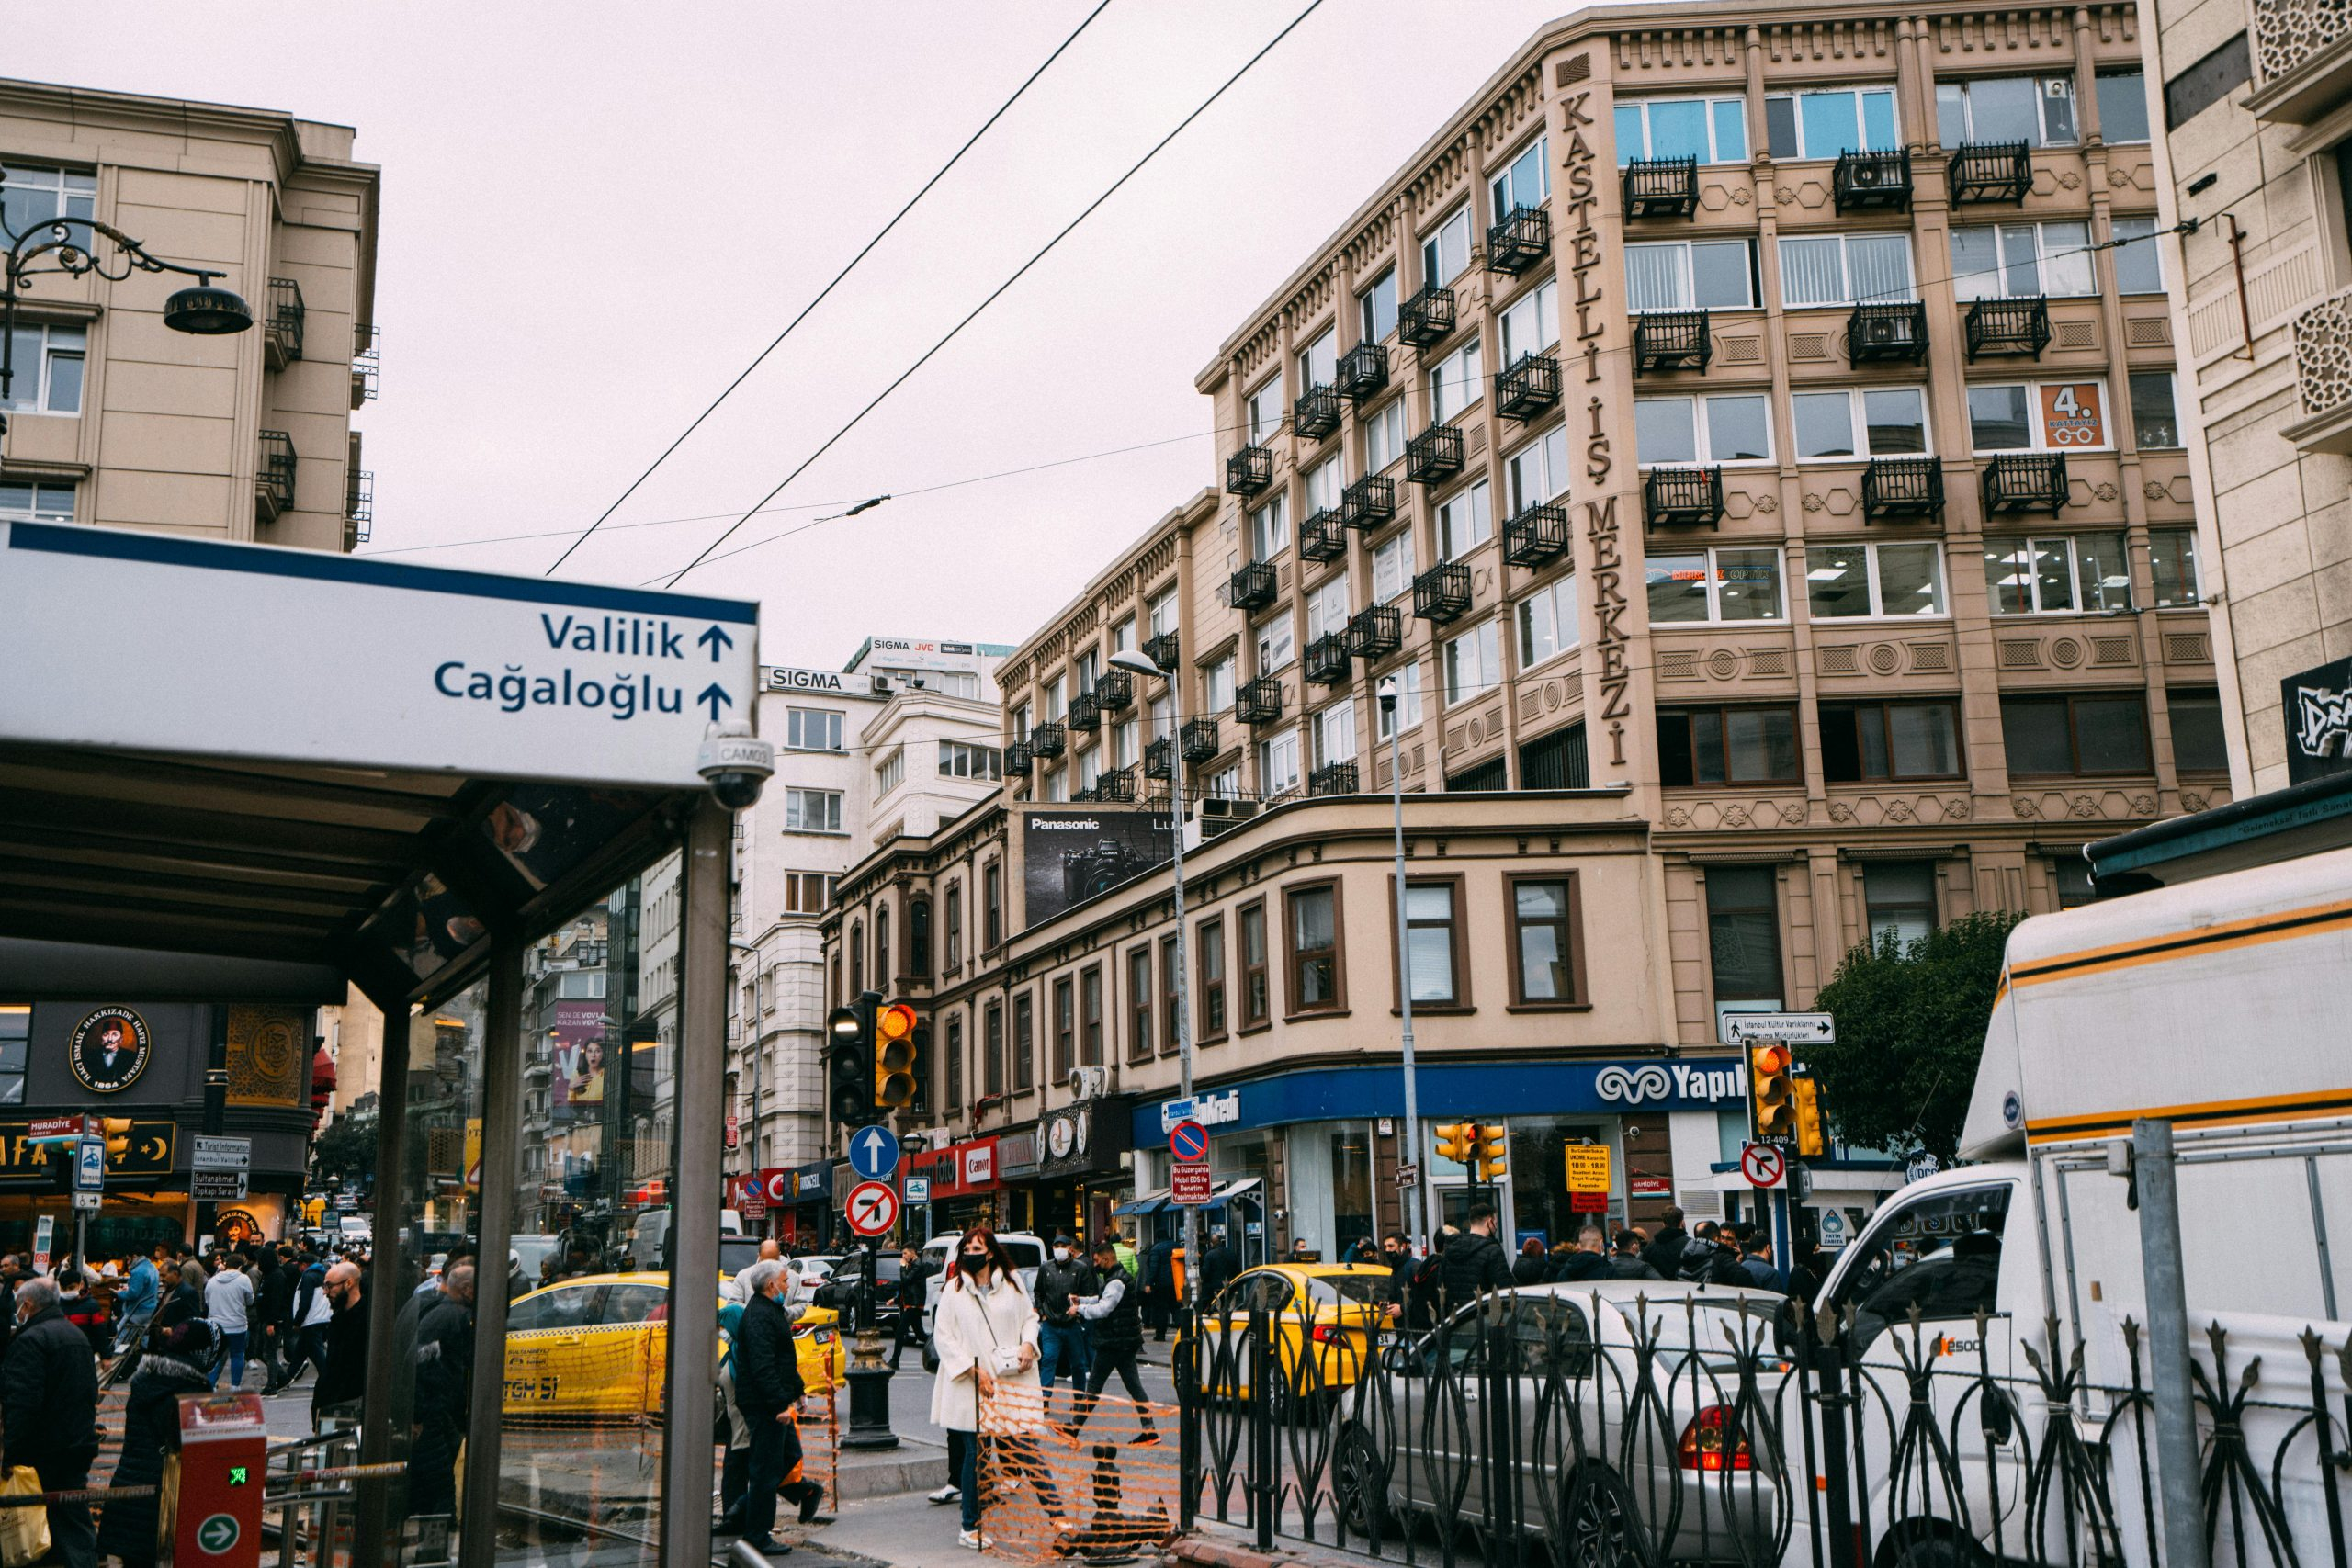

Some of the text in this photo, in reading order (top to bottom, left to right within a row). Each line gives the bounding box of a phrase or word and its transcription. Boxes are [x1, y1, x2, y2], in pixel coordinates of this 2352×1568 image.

[2053, 386, 2093, 418] 4.
[1560, 91, 1630, 766] KASTELLİ İŞ MERKEZİ
[2049, 418, 2098, 428] KATTAYIZ
[1671, 569, 1724, 581] MERKZ
[541, 614, 684, 660] Valilik
[875, 640, 910, 650] SIGMA
[773, 669, 842, 690] SIGMA
[435, 661, 683, 720] Cağaloğlu
[1032, 818, 1100, 830] Panasonic
[84, 1009, 134, 1029] HAKKIZADE
[1744, 1020, 1815, 1029] İstanbul Kültür Varlıklarını
[132, 1021, 146, 1044] HAFIZ
[121, 1047, 146, 1081] MUSTAFA
[75, 1061, 91, 1081] HACI
[31, 1120, 71, 1131] MURADİYE
[968, 1157, 990, 1174] Canon
[1181, 1166, 1209, 1174] Güzergahta
[195, 1175, 235, 1184] Sultanahmet
[194, 1186, 237, 1197] Topkapı Sarayı
[1173, 1193, 1210, 1201] Yapılmaktadır
[216, 1212, 249, 1227] HAKKIZADE
[1380, 1336, 1389, 1344] 34
